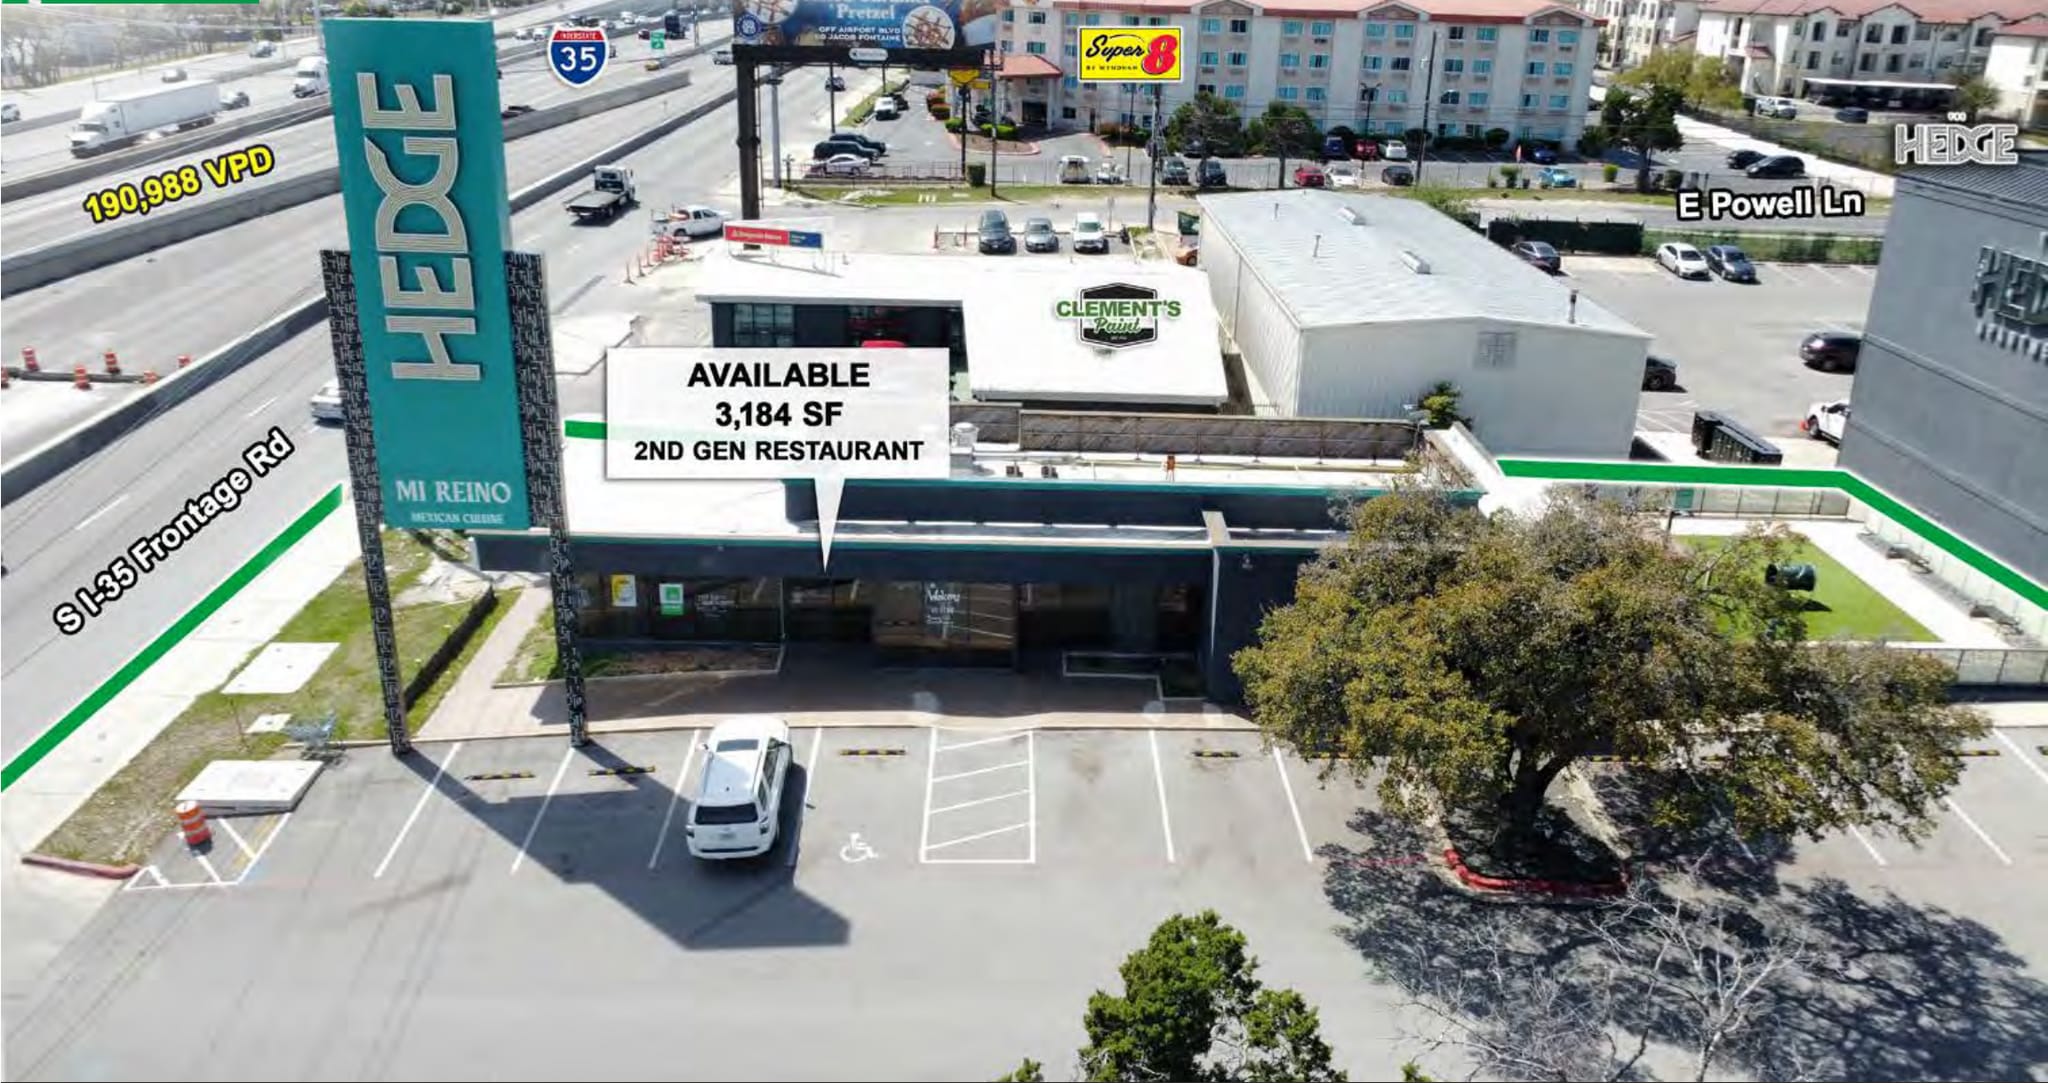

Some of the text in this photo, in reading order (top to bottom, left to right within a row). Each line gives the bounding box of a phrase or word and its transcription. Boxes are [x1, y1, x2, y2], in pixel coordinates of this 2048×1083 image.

[836, 3, 896, 19] Pretzel
[878, 26, 901, 34] BLVD
[357, 72, 481, 382] HEDGE
[395, 480, 512, 504] MI REINO
[411, 512, 460, 523] MEXICAN
